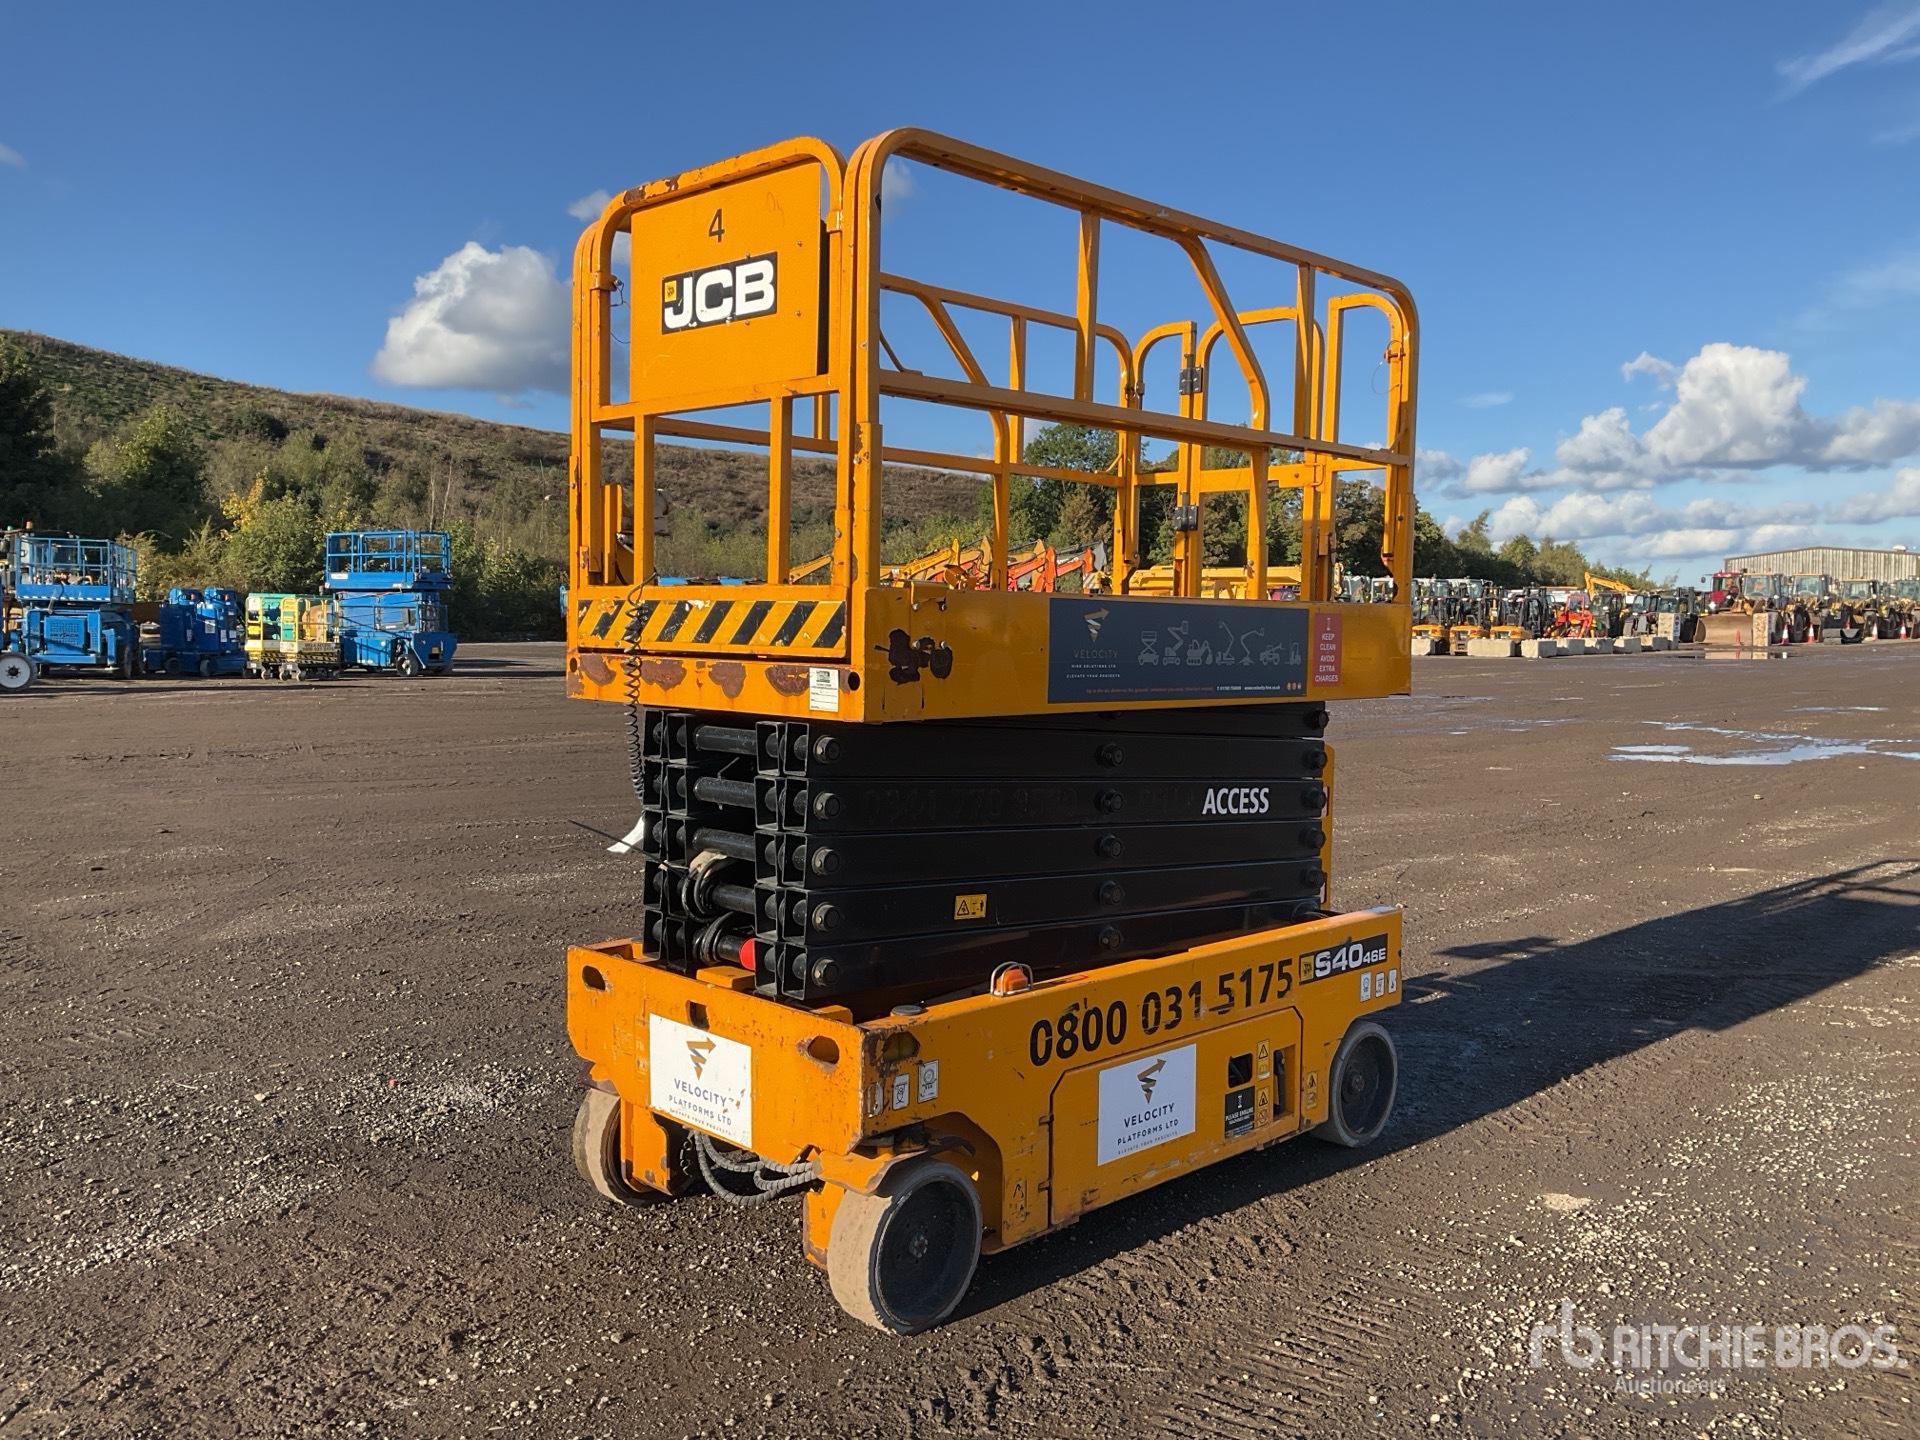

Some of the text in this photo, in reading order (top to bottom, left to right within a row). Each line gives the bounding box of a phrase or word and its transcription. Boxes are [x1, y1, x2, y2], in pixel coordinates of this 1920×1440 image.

[708, 208, 725, 243] 4
[664, 259, 776, 329] JCB
[1319, 643, 1336, 651] CLEAN
[1321, 633, 1335, 641] KEEP
[1073, 649, 1119, 659] VELOCITY
[1320, 654, 1335, 662] AVOID
[1314, 674, 1339, 683] CHARGES
[1202, 787, 1270, 815] ACCESS
[1029, 958, 1294, 1066] 0800 031 5175
[673, 1078, 727, 1107] VELOCITY
[668, 1094, 732, 1126] PLATFORMS LTD
[1123, 1102, 1175, 1128] VELOCITY
[1225, 1111, 1239, 1121] PLEASE
[1117, 1118, 1179, 1146] PLATFORMS LTD
